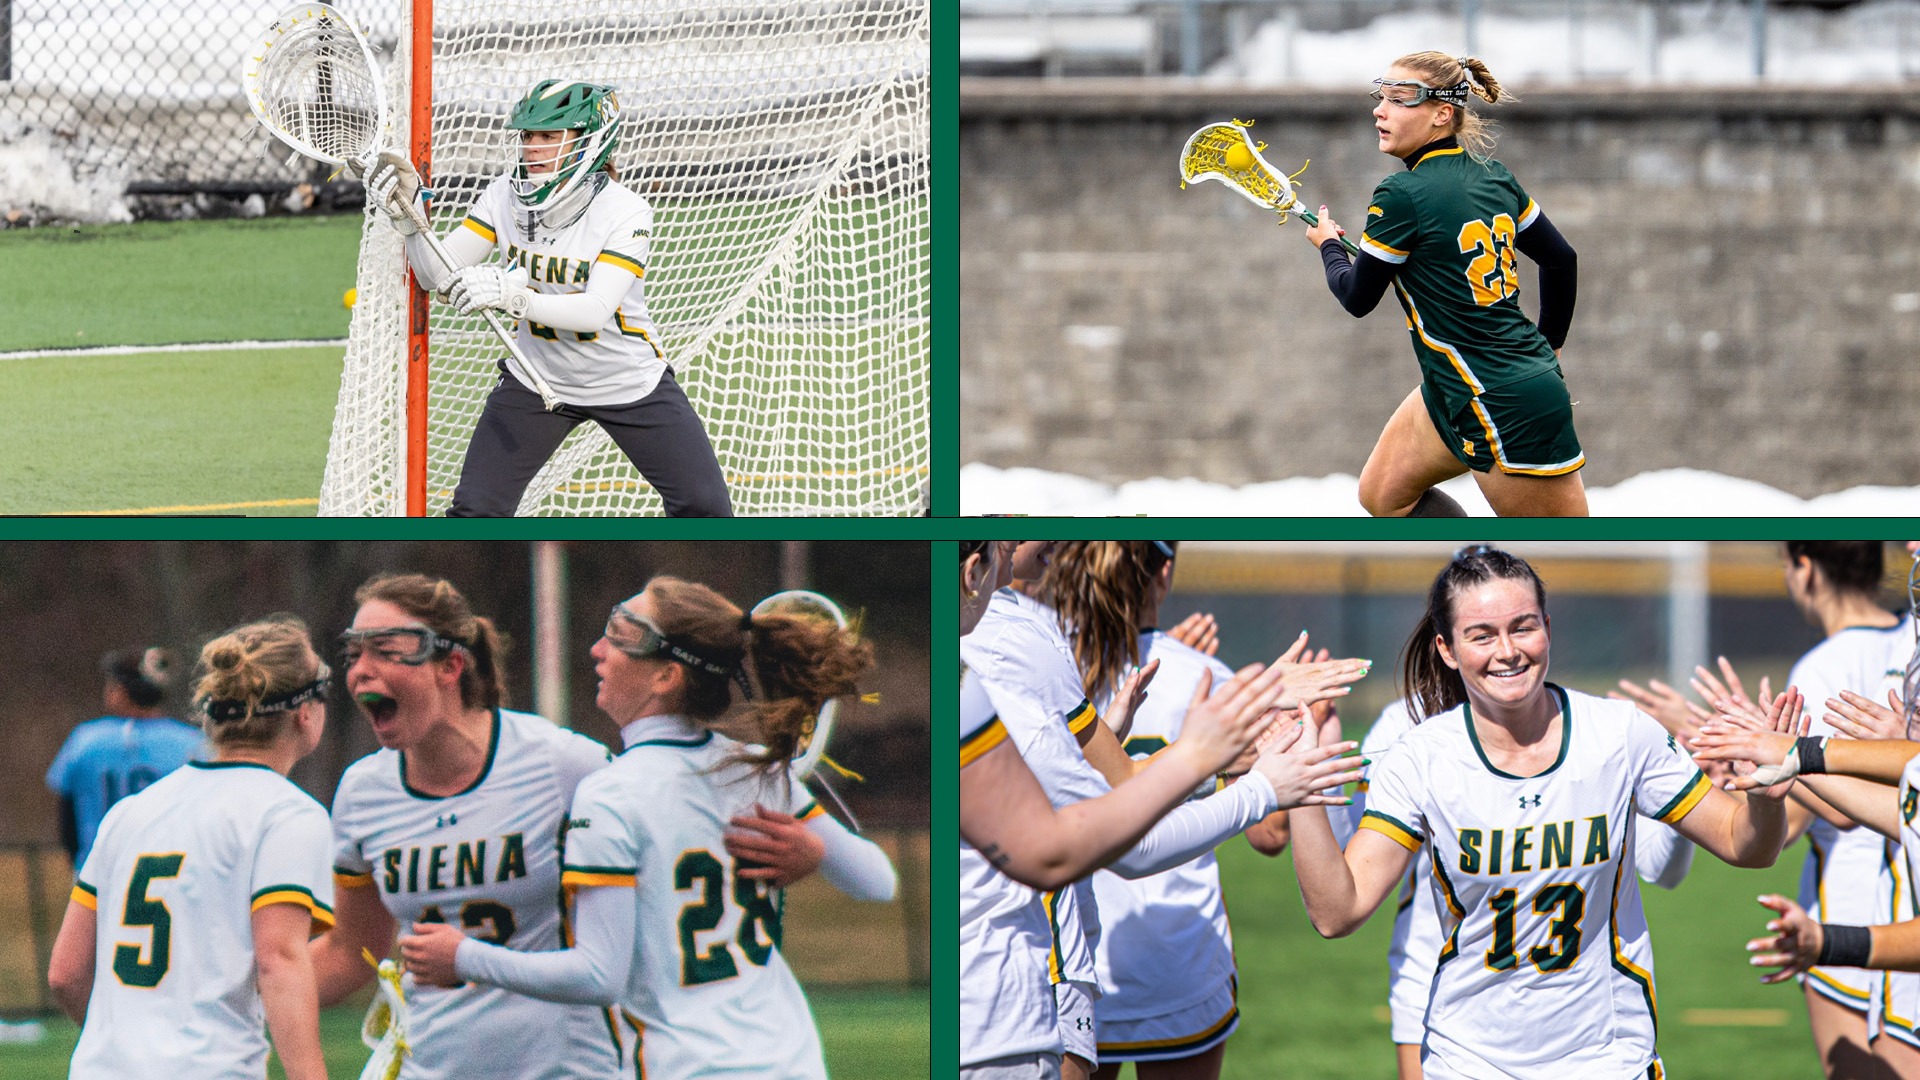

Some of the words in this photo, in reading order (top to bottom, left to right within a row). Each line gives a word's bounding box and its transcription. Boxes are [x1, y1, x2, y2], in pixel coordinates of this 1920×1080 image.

[383, 830, 527, 894] SIENA
[1456, 813, 1611, 876] SIENA
[111, 850, 188, 991] 5
[1484, 881, 1588, 975] 13
